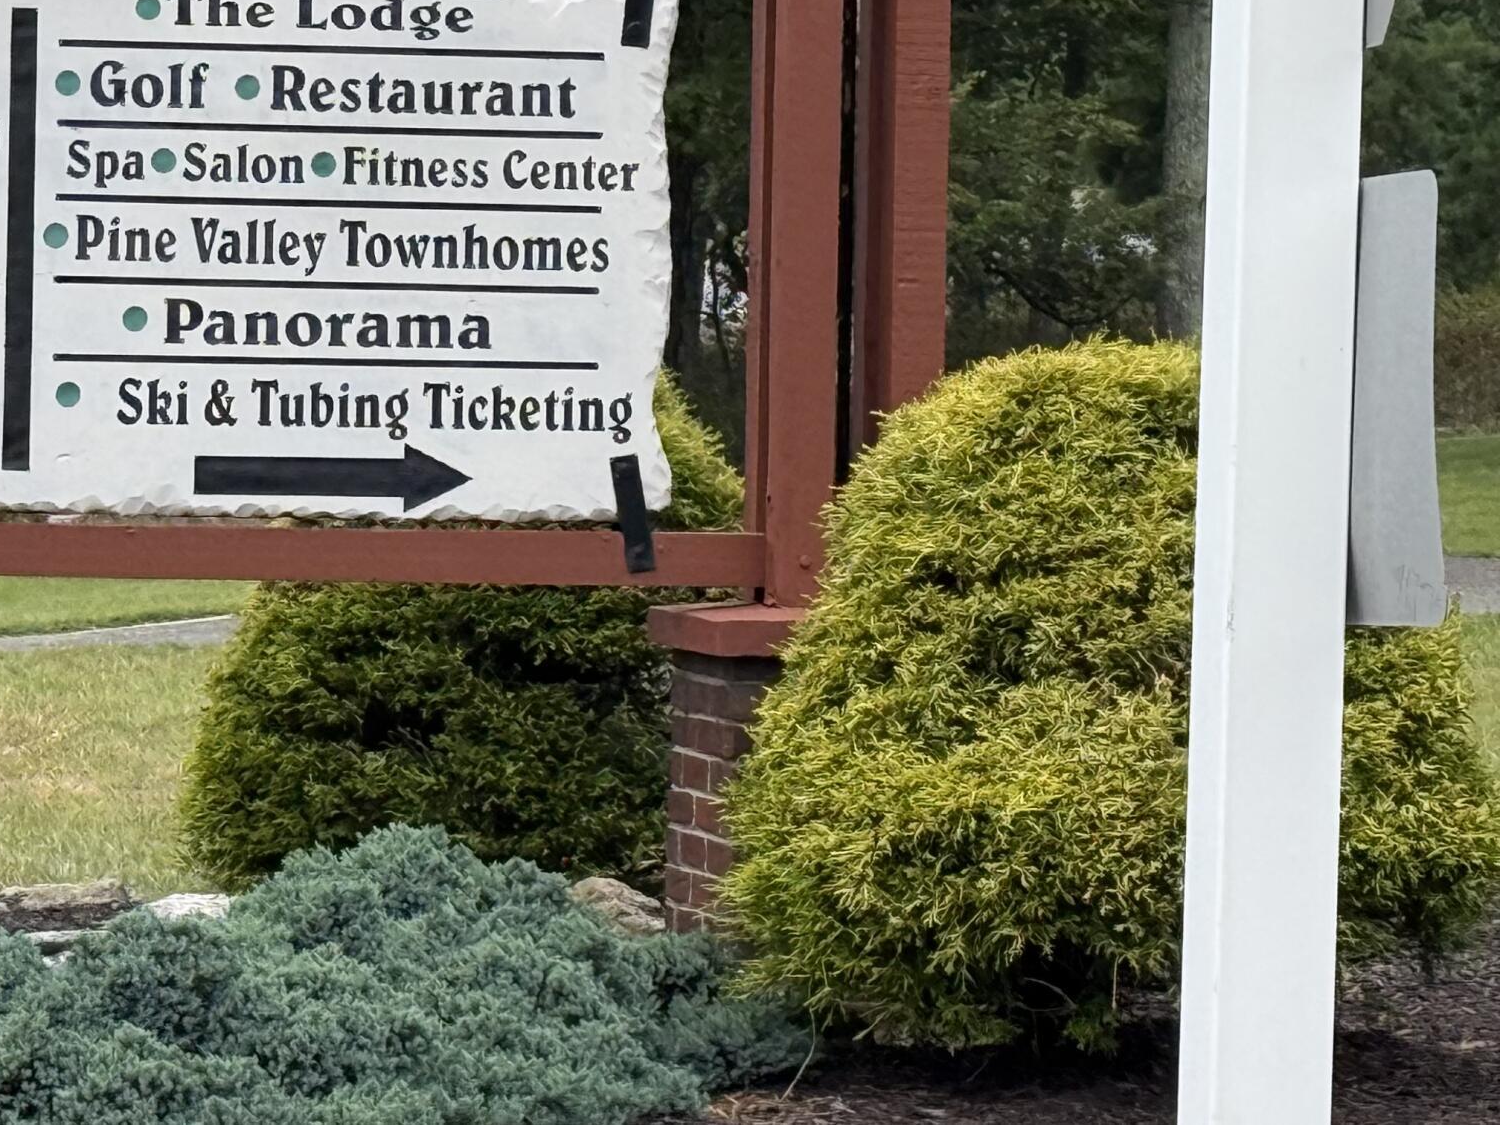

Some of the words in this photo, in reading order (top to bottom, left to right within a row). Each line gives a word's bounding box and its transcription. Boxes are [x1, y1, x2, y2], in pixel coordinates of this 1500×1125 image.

[91, 61, 209, 108] Golf
[271, 65, 576, 118] Restaurant
[67, 140, 143, 188] Spa
[183, 143, 304, 183] Salon
[343, 147, 488, 188] Fitness
[503, 150, 639, 191] Center
[76, 215, 176, 262] Pine
[191, 218, 326, 276] Valley
[340, 219, 608, 272] Townhomes
[165, 299, 491, 349] Panorama
[117, 378, 188, 424] Ski
[205, 380, 237, 426] &
[251, 379, 408, 440] Tubing
[423, 382, 632, 444] Ticketing
